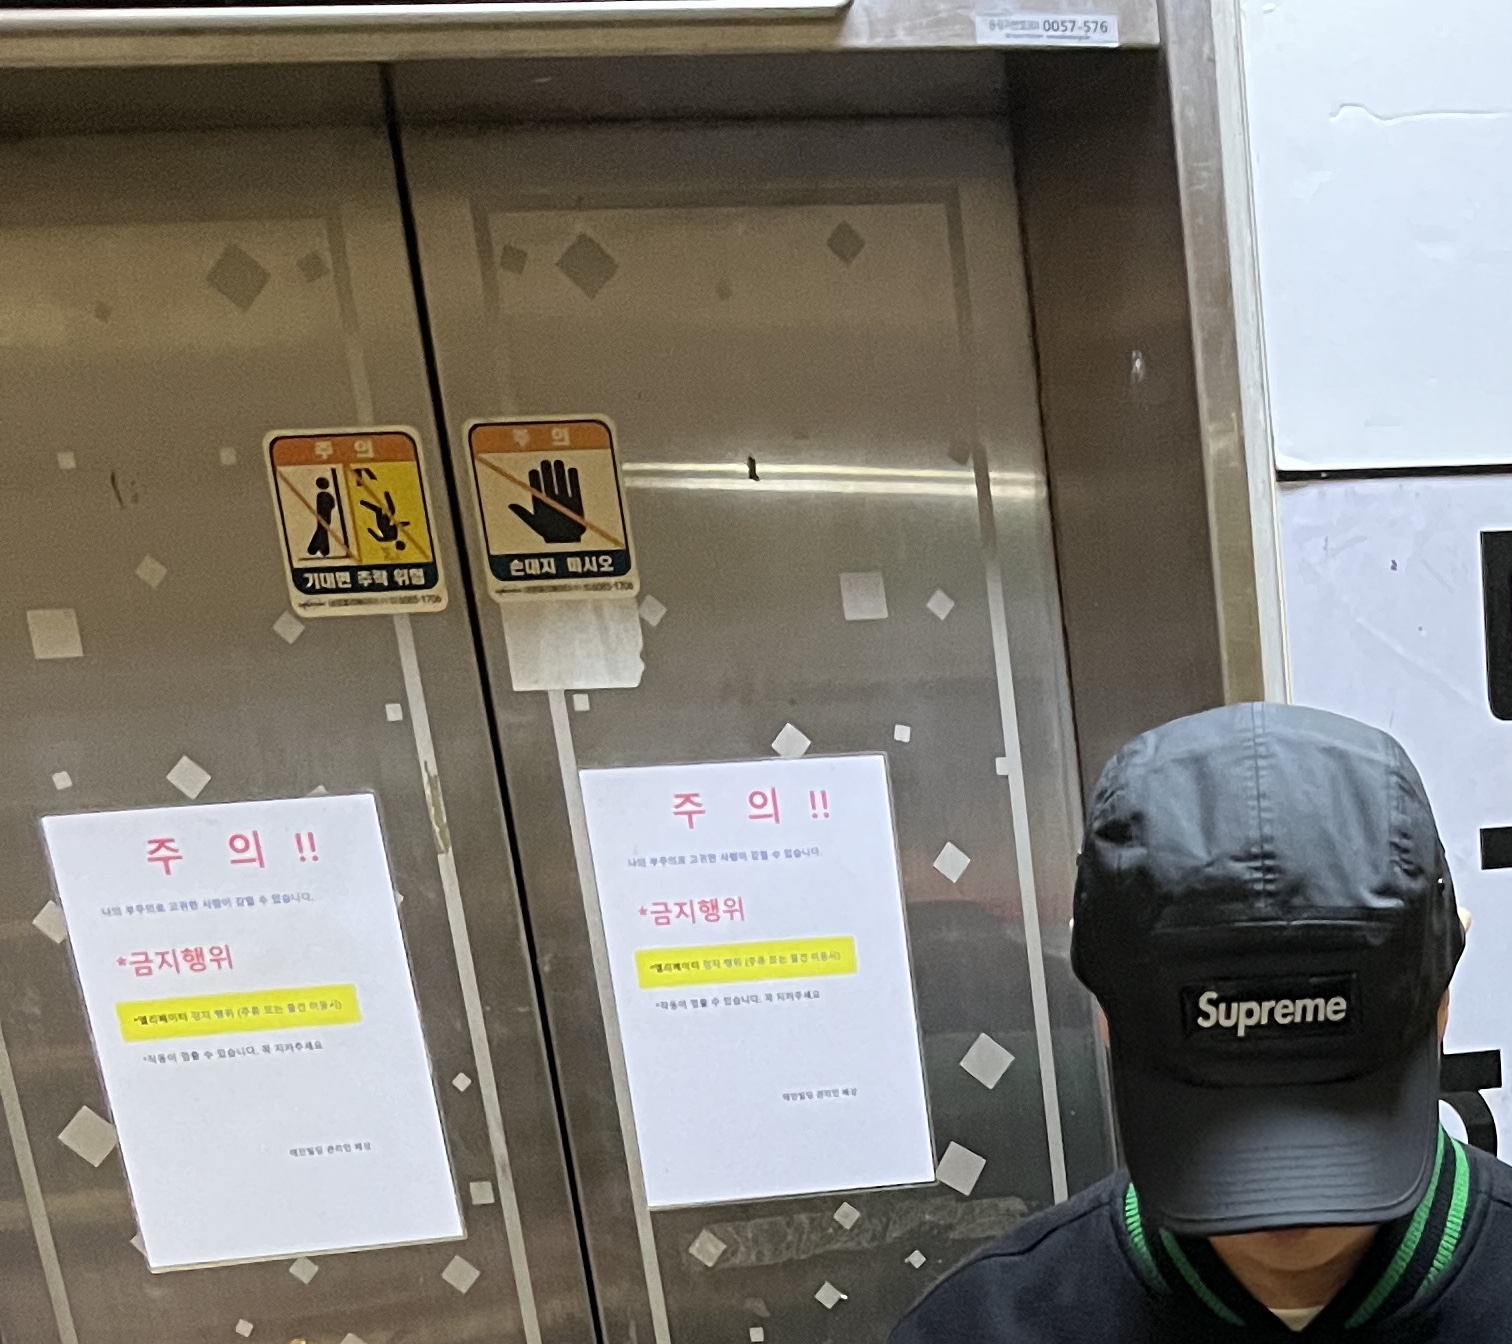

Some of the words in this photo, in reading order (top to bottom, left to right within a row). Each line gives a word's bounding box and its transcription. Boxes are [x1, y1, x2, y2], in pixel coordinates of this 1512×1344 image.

[1043, 19, 1109, 34] 0057-576
[672, 792, 707, 830] 주
[747, 786, 782, 825] 의
[146, 837, 184, 876] 주
[228, 829, 266, 869] 의
[1197, 990, 1348, 1037] Supreme
